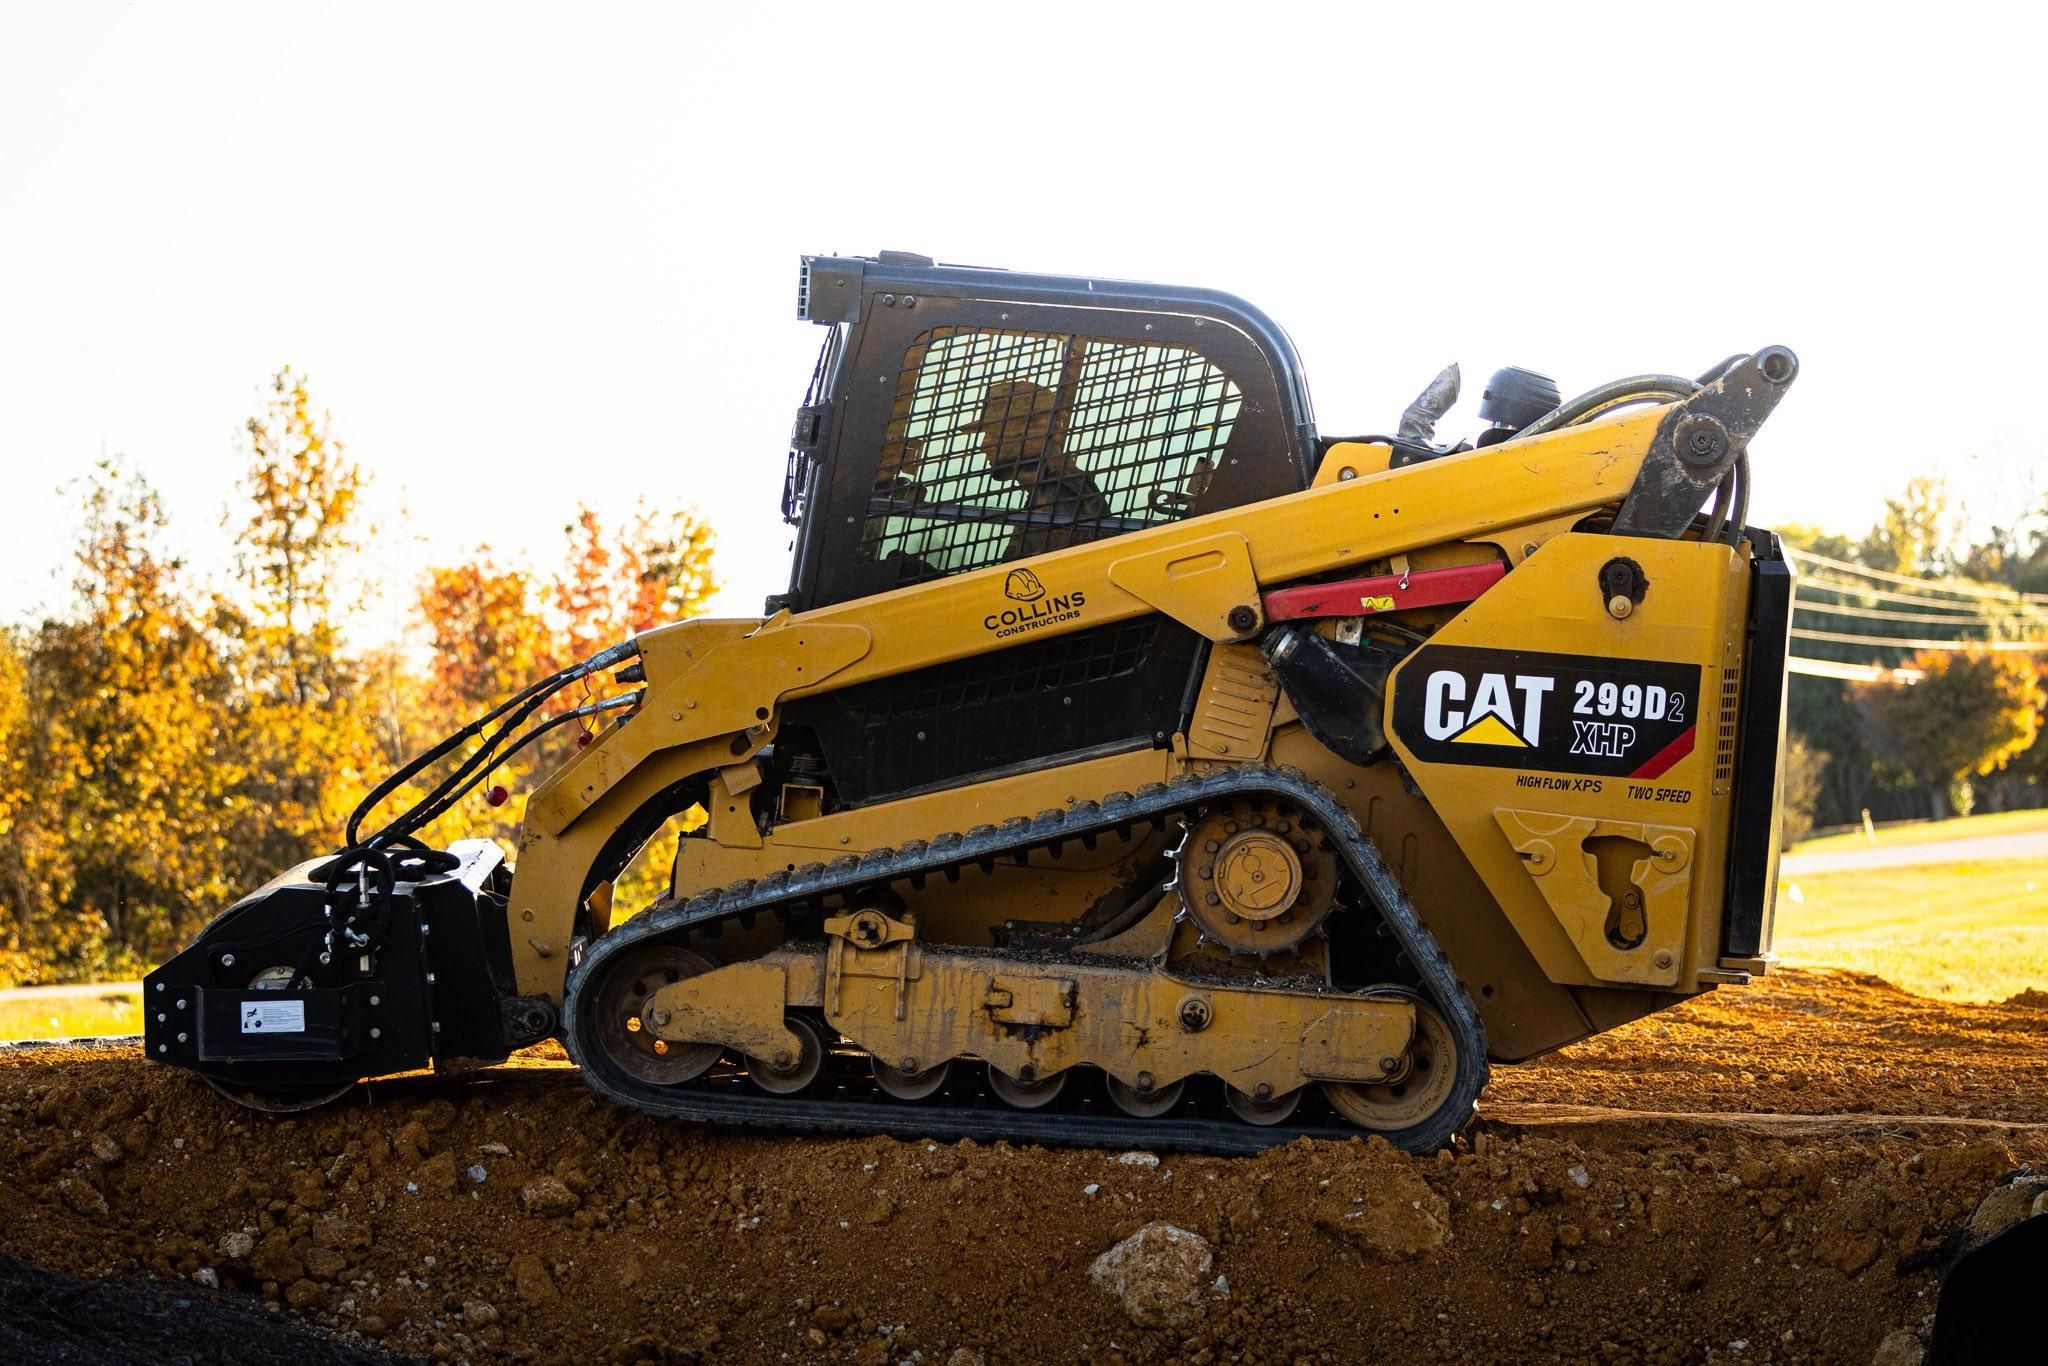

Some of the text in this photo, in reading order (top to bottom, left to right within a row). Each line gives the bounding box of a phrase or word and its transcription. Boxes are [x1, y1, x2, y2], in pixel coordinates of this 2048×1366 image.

[984, 592, 1086, 630] COLLINS
[996, 611, 1081, 638] CONSTRUCTORS
[1423, 670, 1555, 748] CAT
[1569, 721, 1636, 757] XHP
[1516, 775, 1602, 793] HIGH FLOW XPS
[1627, 785, 1692, 803] TWO SPEED
